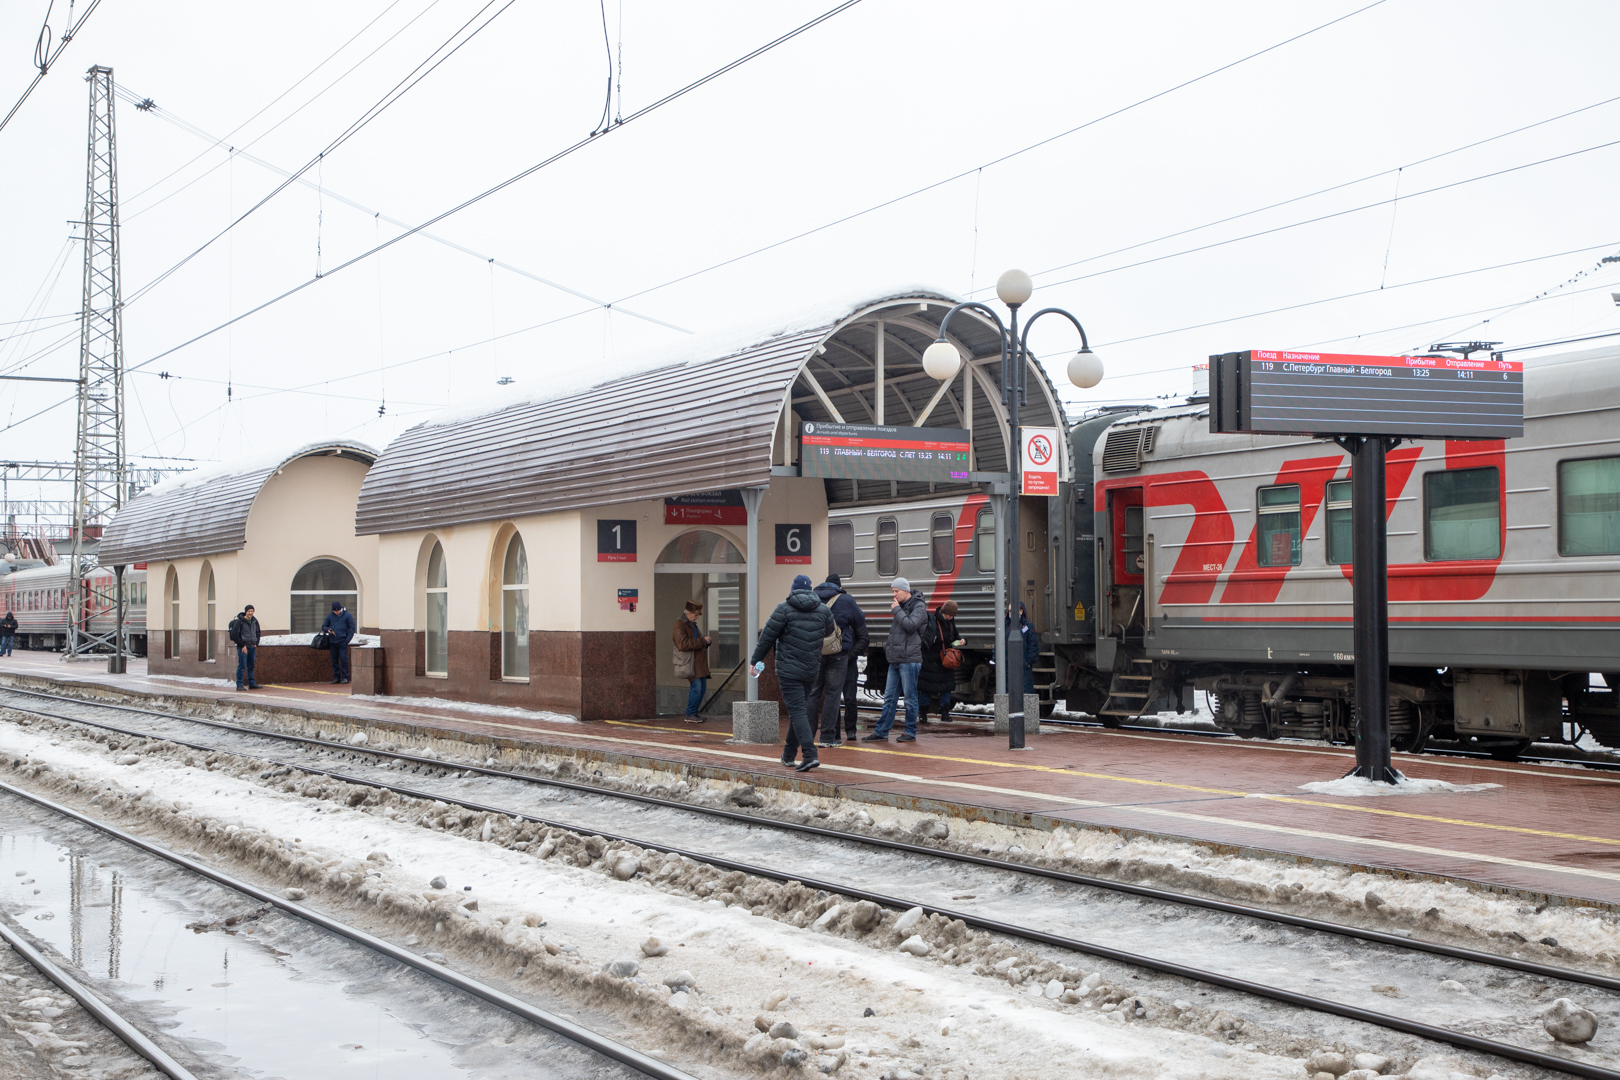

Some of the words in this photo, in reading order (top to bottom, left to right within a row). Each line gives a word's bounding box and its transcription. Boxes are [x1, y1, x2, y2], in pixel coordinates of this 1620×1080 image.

[1257, 351, 1277, 360] Поезд
[1282, 352, 1320, 361] Назначение
[1406, 358, 1436, 366] Прибытие
[1446, 360, 1484, 368] Отправление
[1498, 362, 1512, 370] Путь
[1262, 362, 1274, 370] 119
[1282, 363, 1325, 374] С.Петербург
[1326, 364, 1354, 374] Главный
[1360, 366, 1392, 376] Белгород
[866, 450, 896, 458] БЕЛГОРОД
[680, 508, 684, 518] 1
[612, 524, 621, 549] 1
[786, 528, 800, 552] 6
